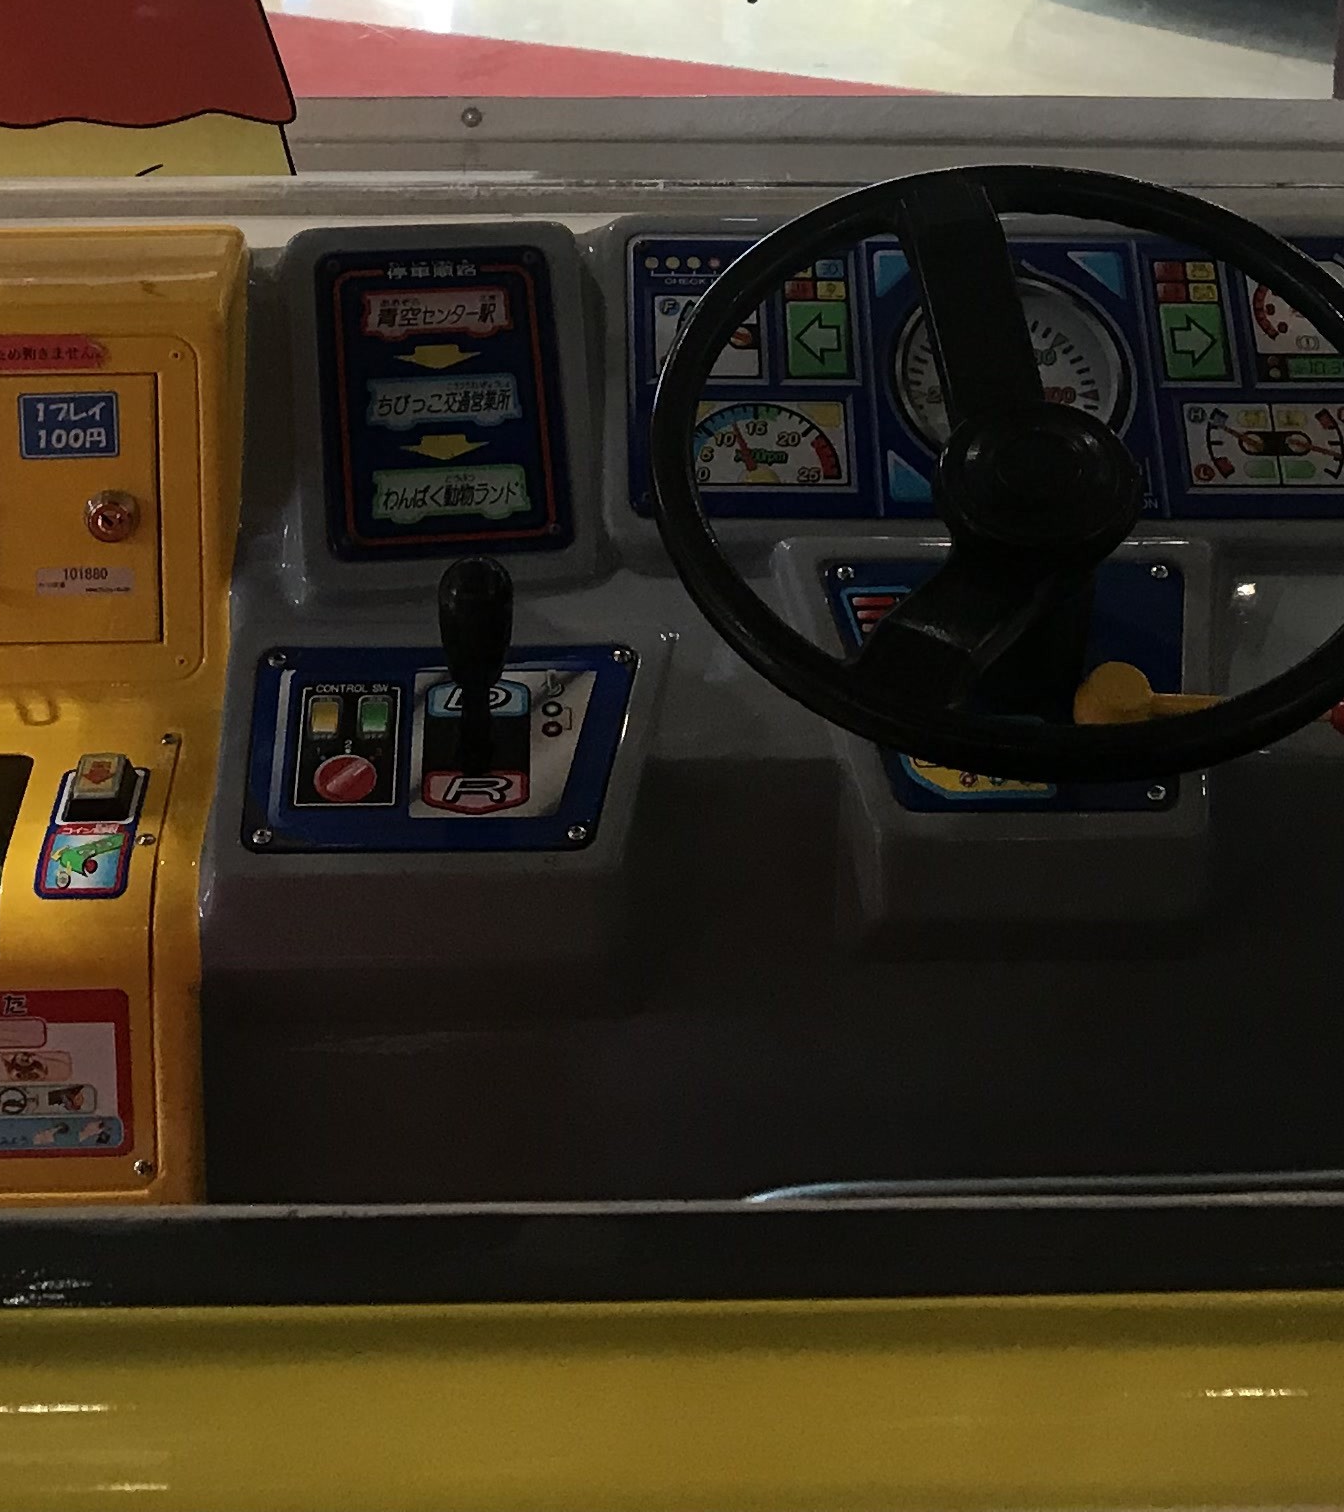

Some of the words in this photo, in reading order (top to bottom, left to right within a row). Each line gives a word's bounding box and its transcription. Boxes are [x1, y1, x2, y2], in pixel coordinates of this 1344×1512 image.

[377, 303, 497, 328] 青空センター駅
[36, 401, 106, 423] 1プレイ
[37, 429, 106, 449] 100円
[714, 432, 736, 447] 10
[776, 432, 801, 447] 20
[797, 466, 821, 482] 25
[316, 684, 368, 693] CONTROL
[372, 684, 389, 693] SW
[443, 775, 512, 804] R
